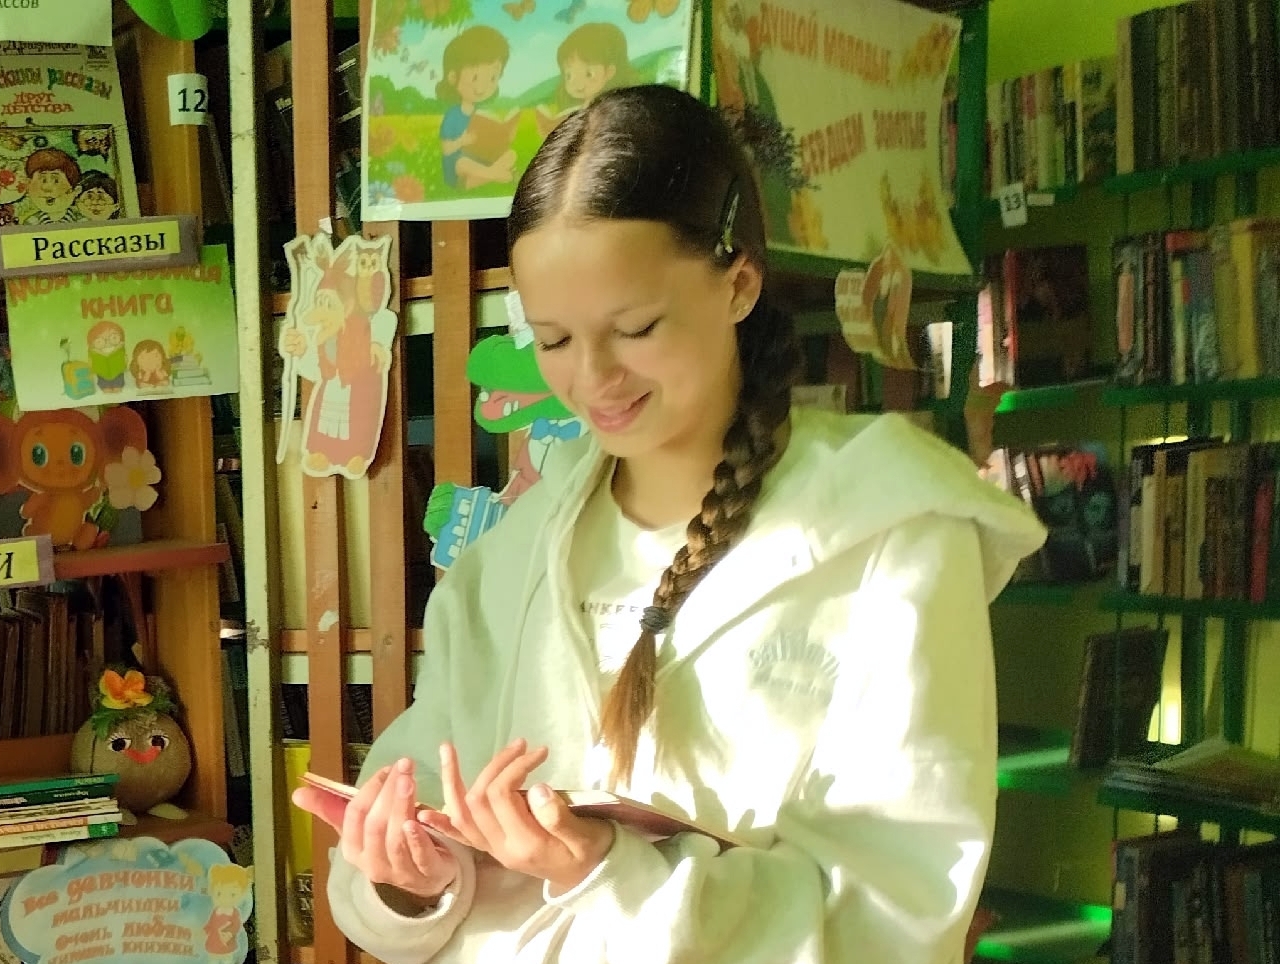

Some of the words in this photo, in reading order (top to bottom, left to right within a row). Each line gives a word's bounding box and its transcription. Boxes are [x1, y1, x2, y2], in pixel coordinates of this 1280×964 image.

[177, 88, 206, 113] 12
[31, 229, 167, 261] Рассказы
[66, 869, 195, 905] девчонки
[51, 898, 179, 928] мальчишки
